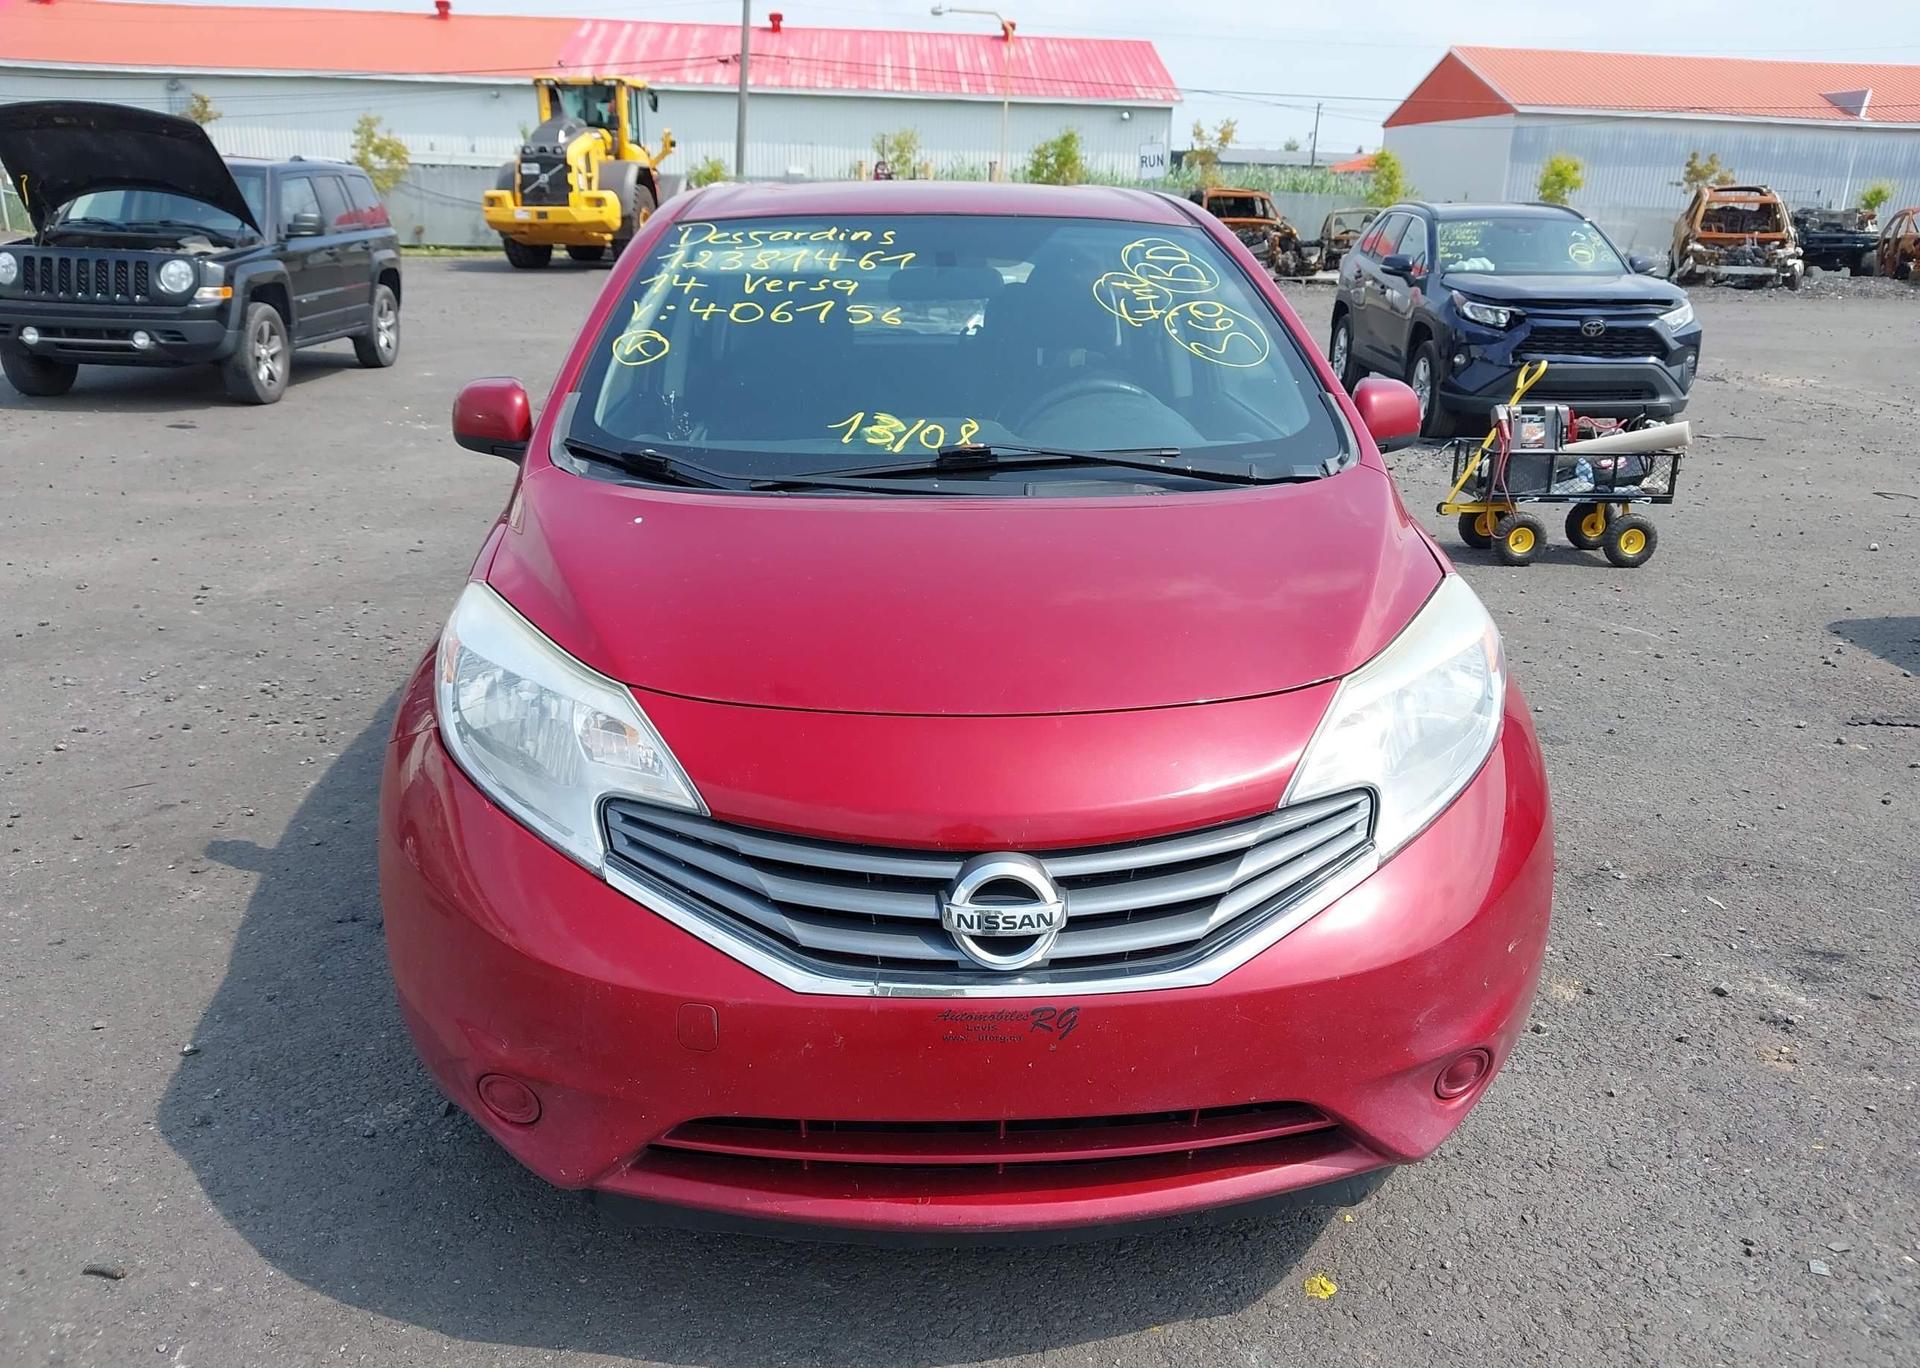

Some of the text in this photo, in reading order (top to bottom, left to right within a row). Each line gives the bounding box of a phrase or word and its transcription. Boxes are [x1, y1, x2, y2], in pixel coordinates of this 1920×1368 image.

[1141, 154, 1164, 168] RUN
[641, 273, 709, 294] 14
[956, 912, 1054, 931] NISSAN
[938, 1006, 1080, 1040] Automobiles RG
